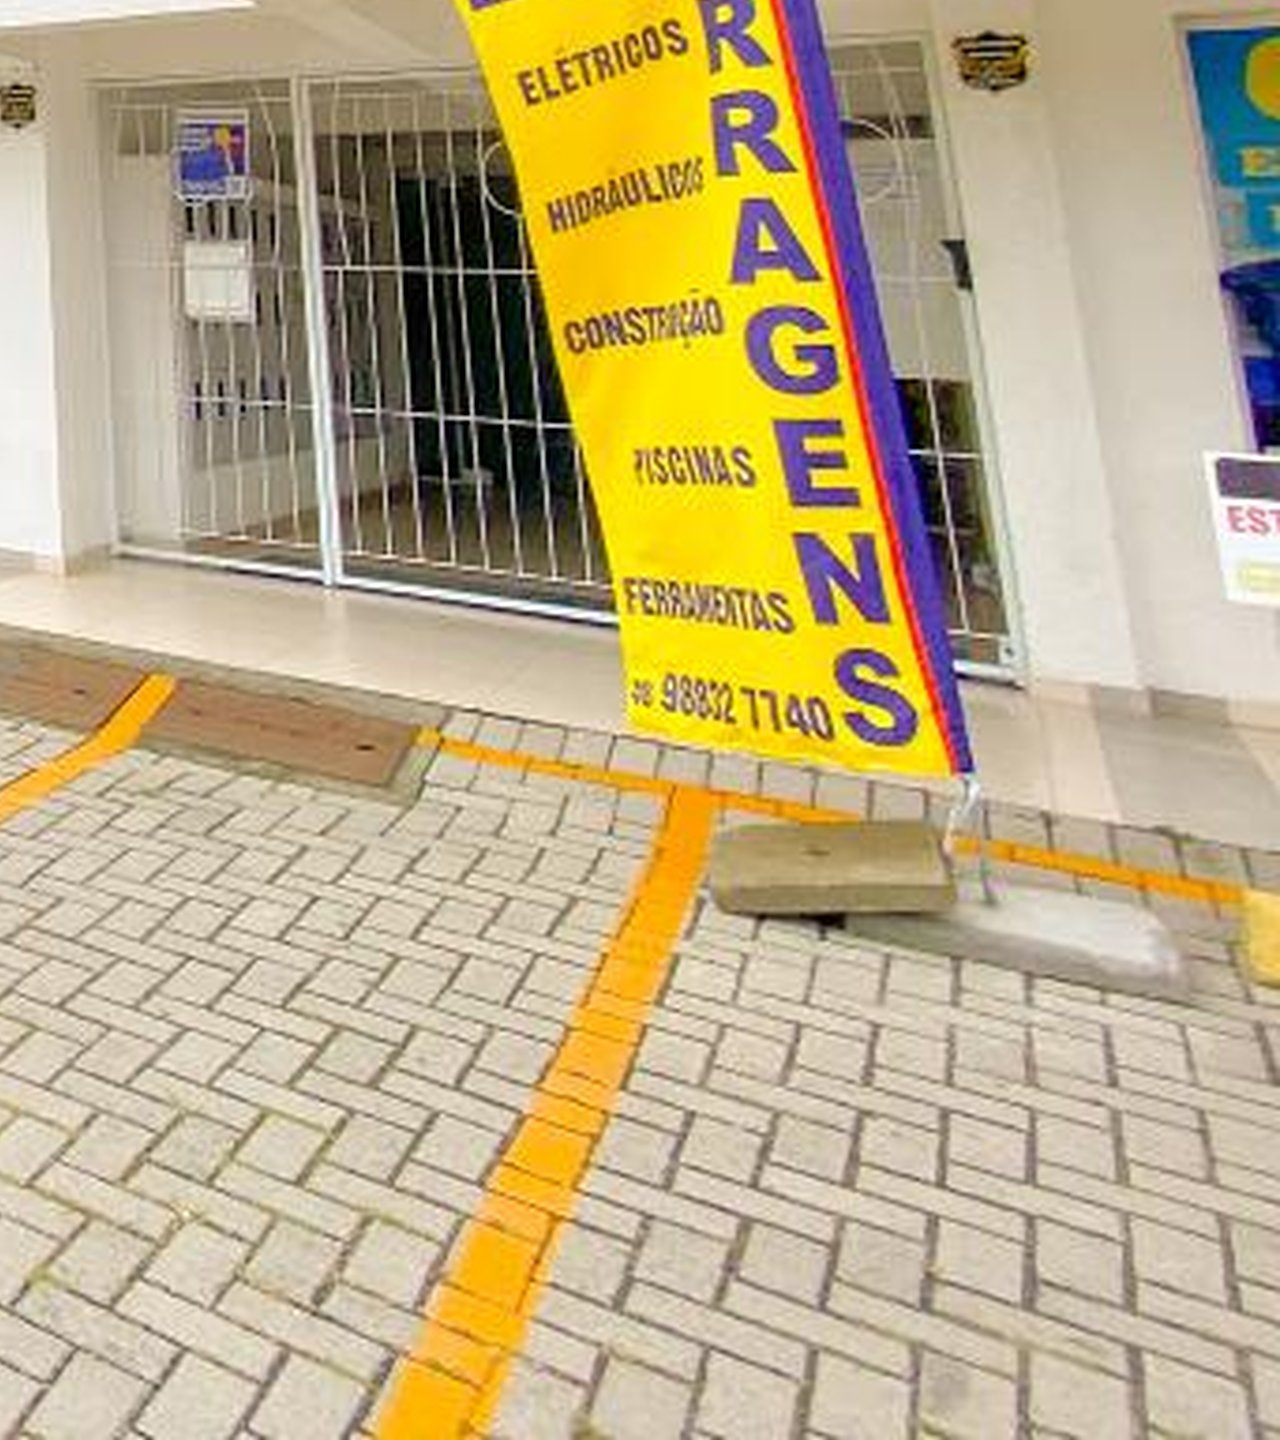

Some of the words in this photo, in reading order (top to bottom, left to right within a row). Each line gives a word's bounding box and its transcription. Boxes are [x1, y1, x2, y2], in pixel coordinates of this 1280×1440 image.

[634, 446, 757, 487] PISCINAS
[623, 576, 796, 635] FERRAMENTAS
[739, 685, 835, 742] 7740
